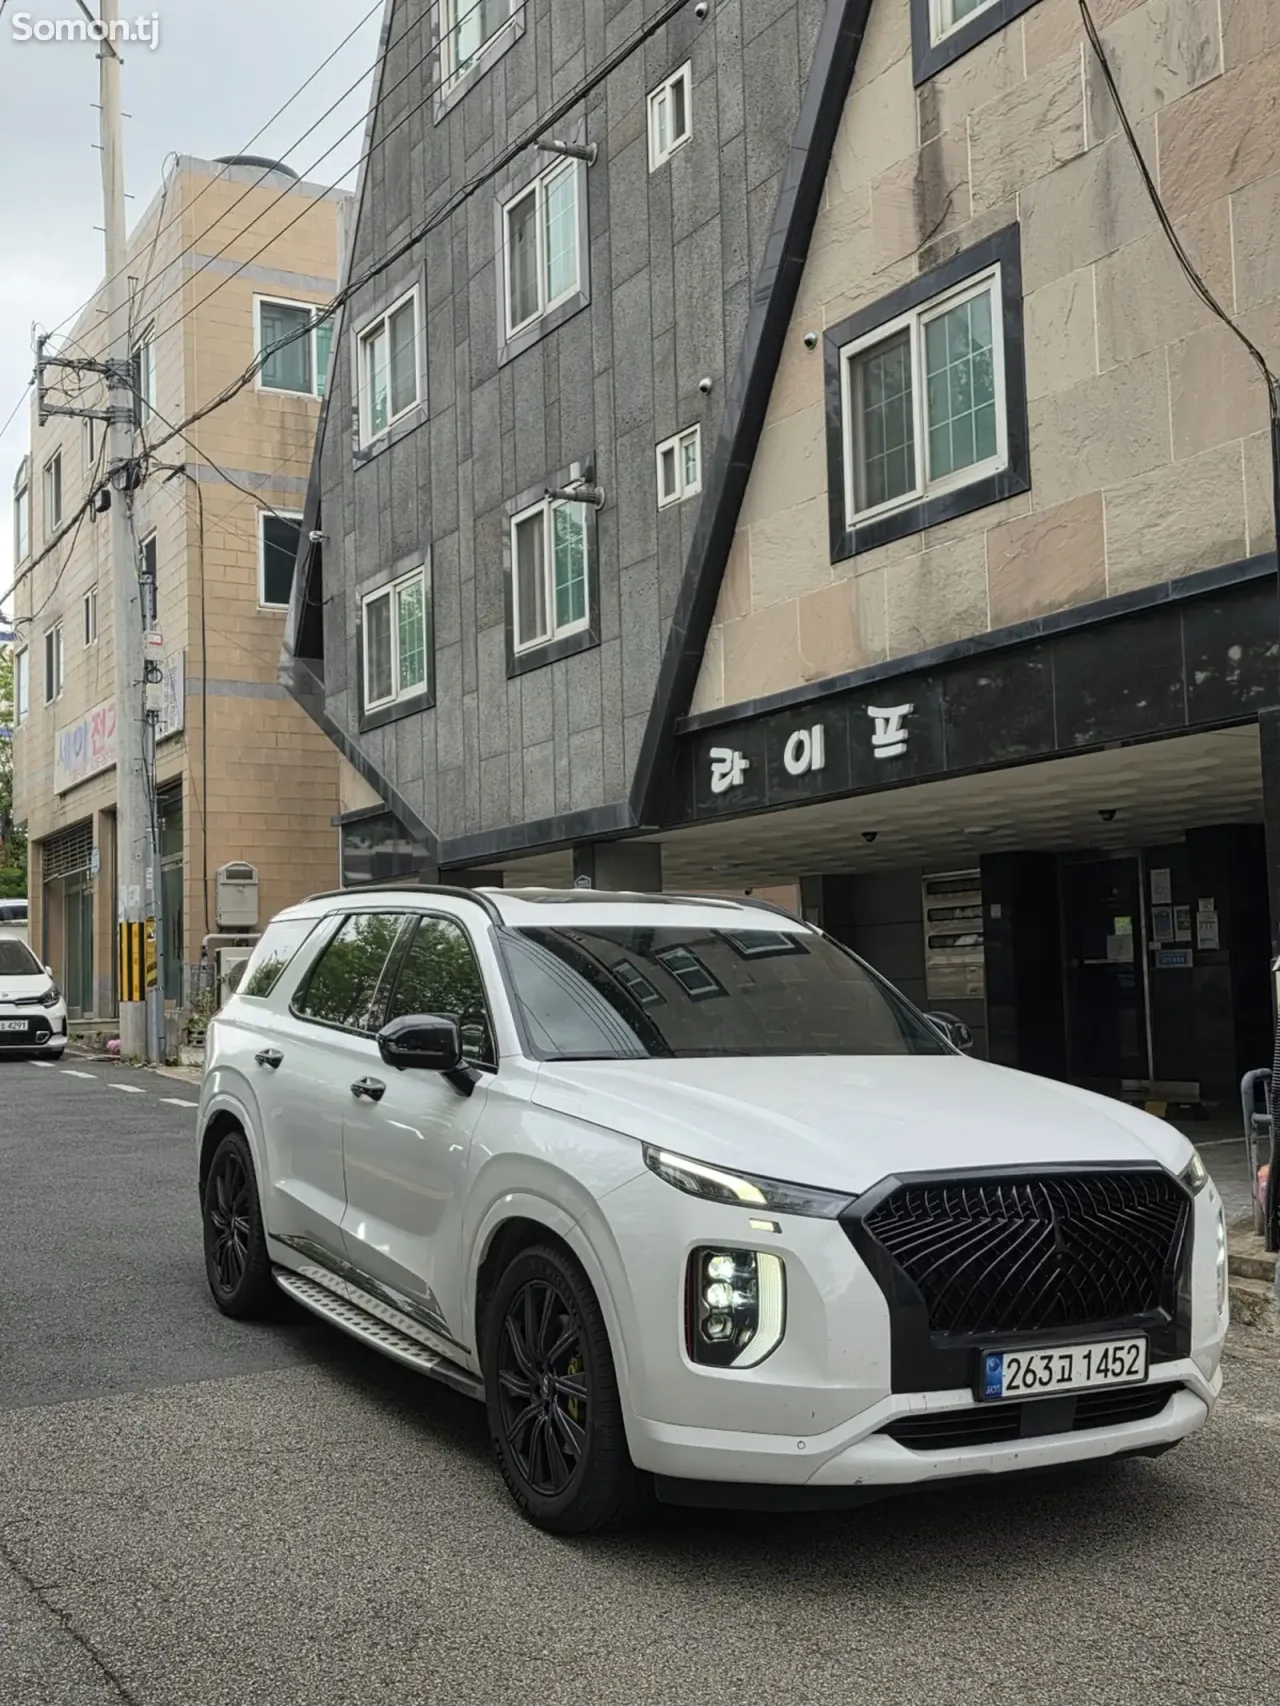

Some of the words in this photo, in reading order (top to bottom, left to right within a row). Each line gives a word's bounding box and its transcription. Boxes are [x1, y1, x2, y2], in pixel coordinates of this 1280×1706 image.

[710, 703, 914, 793] 라이프
[7, 1021, 26, 1029] 4291
[1006, 1354, 1073, 1391] 263고
[1083, 1344, 1140, 1381] 1452
